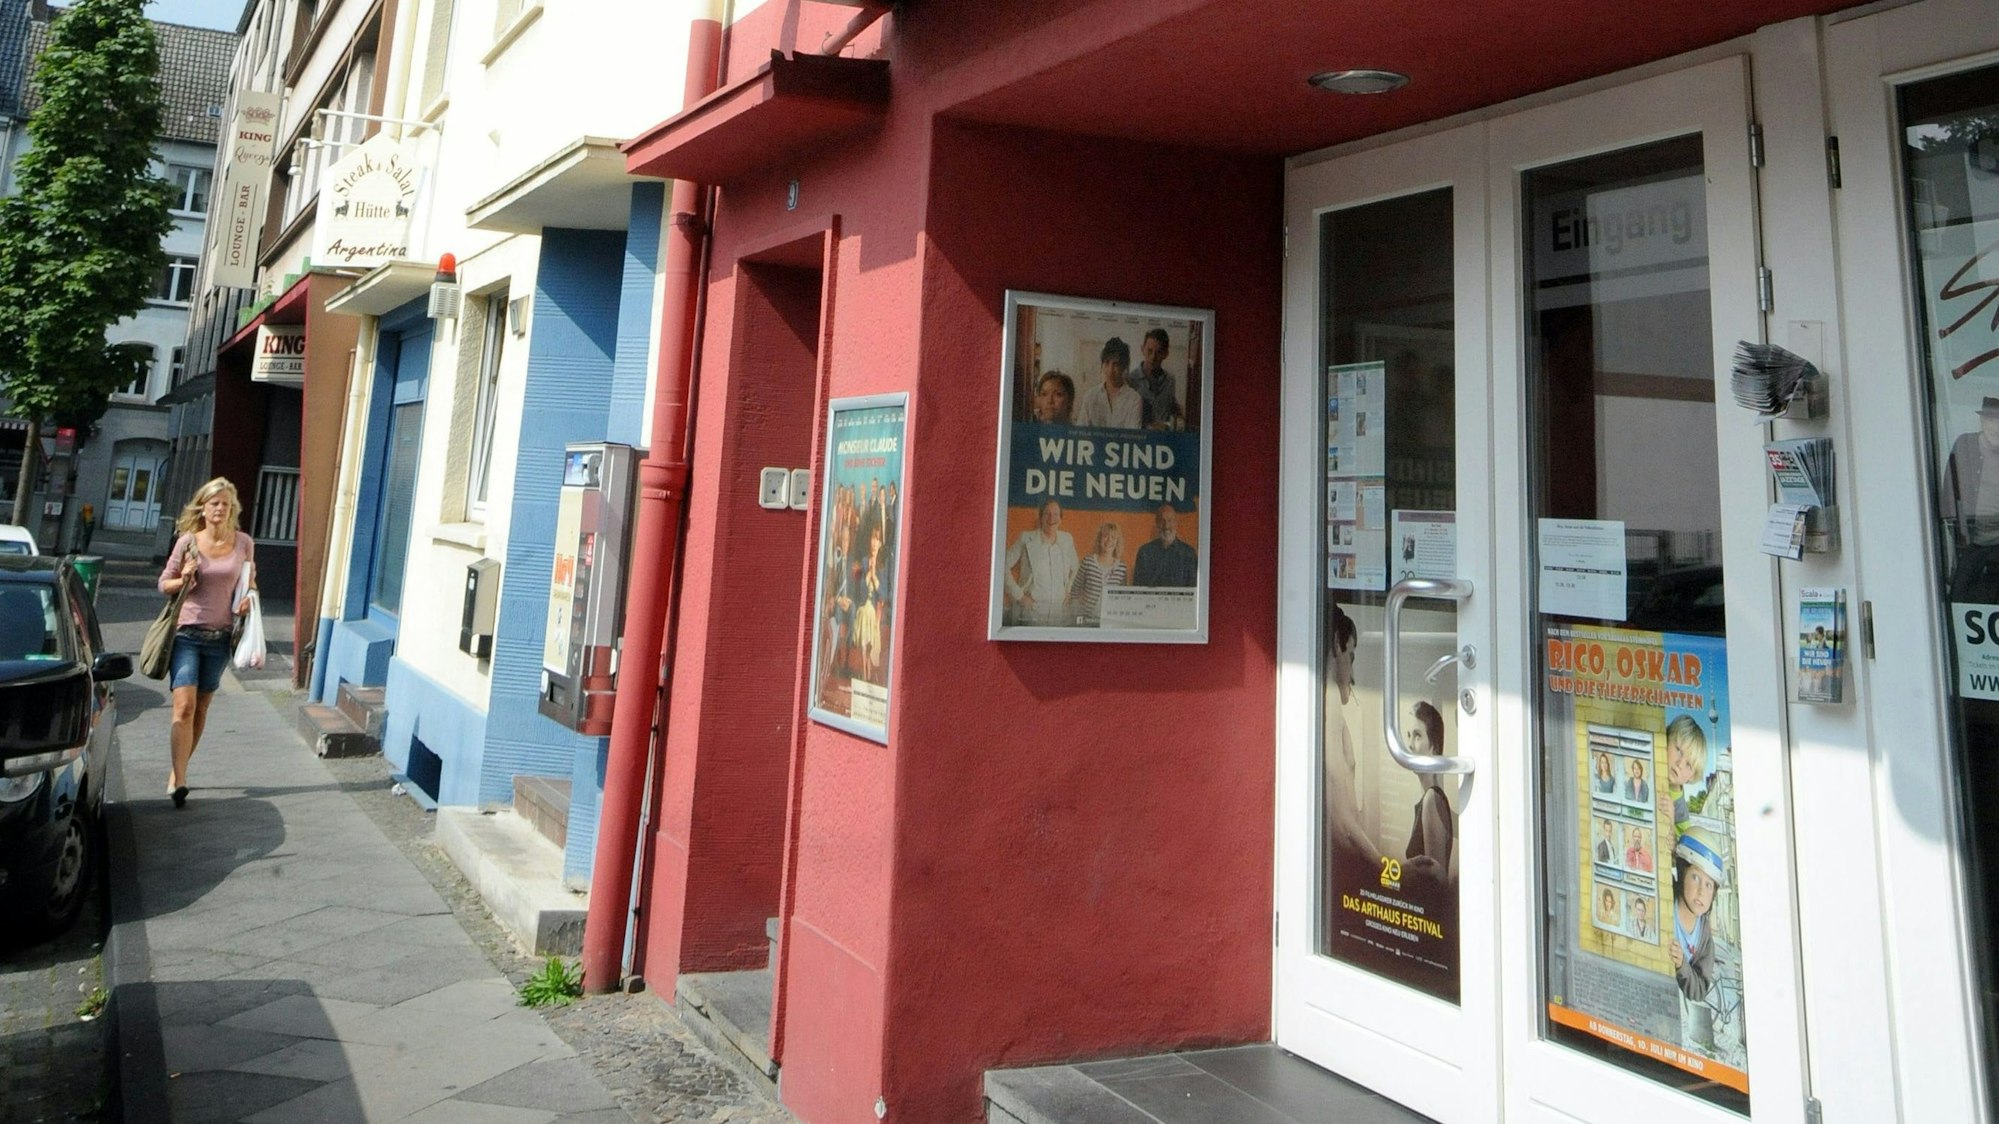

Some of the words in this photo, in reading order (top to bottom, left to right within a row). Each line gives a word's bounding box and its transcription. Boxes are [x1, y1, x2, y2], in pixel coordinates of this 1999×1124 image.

[239, 131, 272, 142] KING
[333, 153, 373, 197] Steak
[386, 153, 415, 197] Salat
[230, 217, 245, 266] LOUNGE
[239, 185, 250, 208] BAR
[354, 201, 390, 218] Hütte
[1552, 201, 1693, 255] Eingang
[327, 238, 407, 262] Argentina
[262, 336, 305, 355] KING
[870, 437, 897, 452] CLAUDE
[1038, 437, 1096, 466] WIR
[1104, 442, 1175, 471] SIND
[1025, 468, 1075, 498] DIE
[1086, 472, 1186, 502] NEUEN
[1547, 639, 1612, 681] RICO,
[1616, 645, 1703, 690] OSKAR
[1548, 675, 1574, 693] UND
[1574, 677, 1597, 698] DIE
[1597, 681, 1704, 710] TIEFERSCHATTEN
[1381, 856, 1401, 881] 20
[1342, 894, 1360, 913] DAS
[1361, 901, 1401, 926] ARTHAUS
[1402, 912, 1444, 939] FESTIVAL
